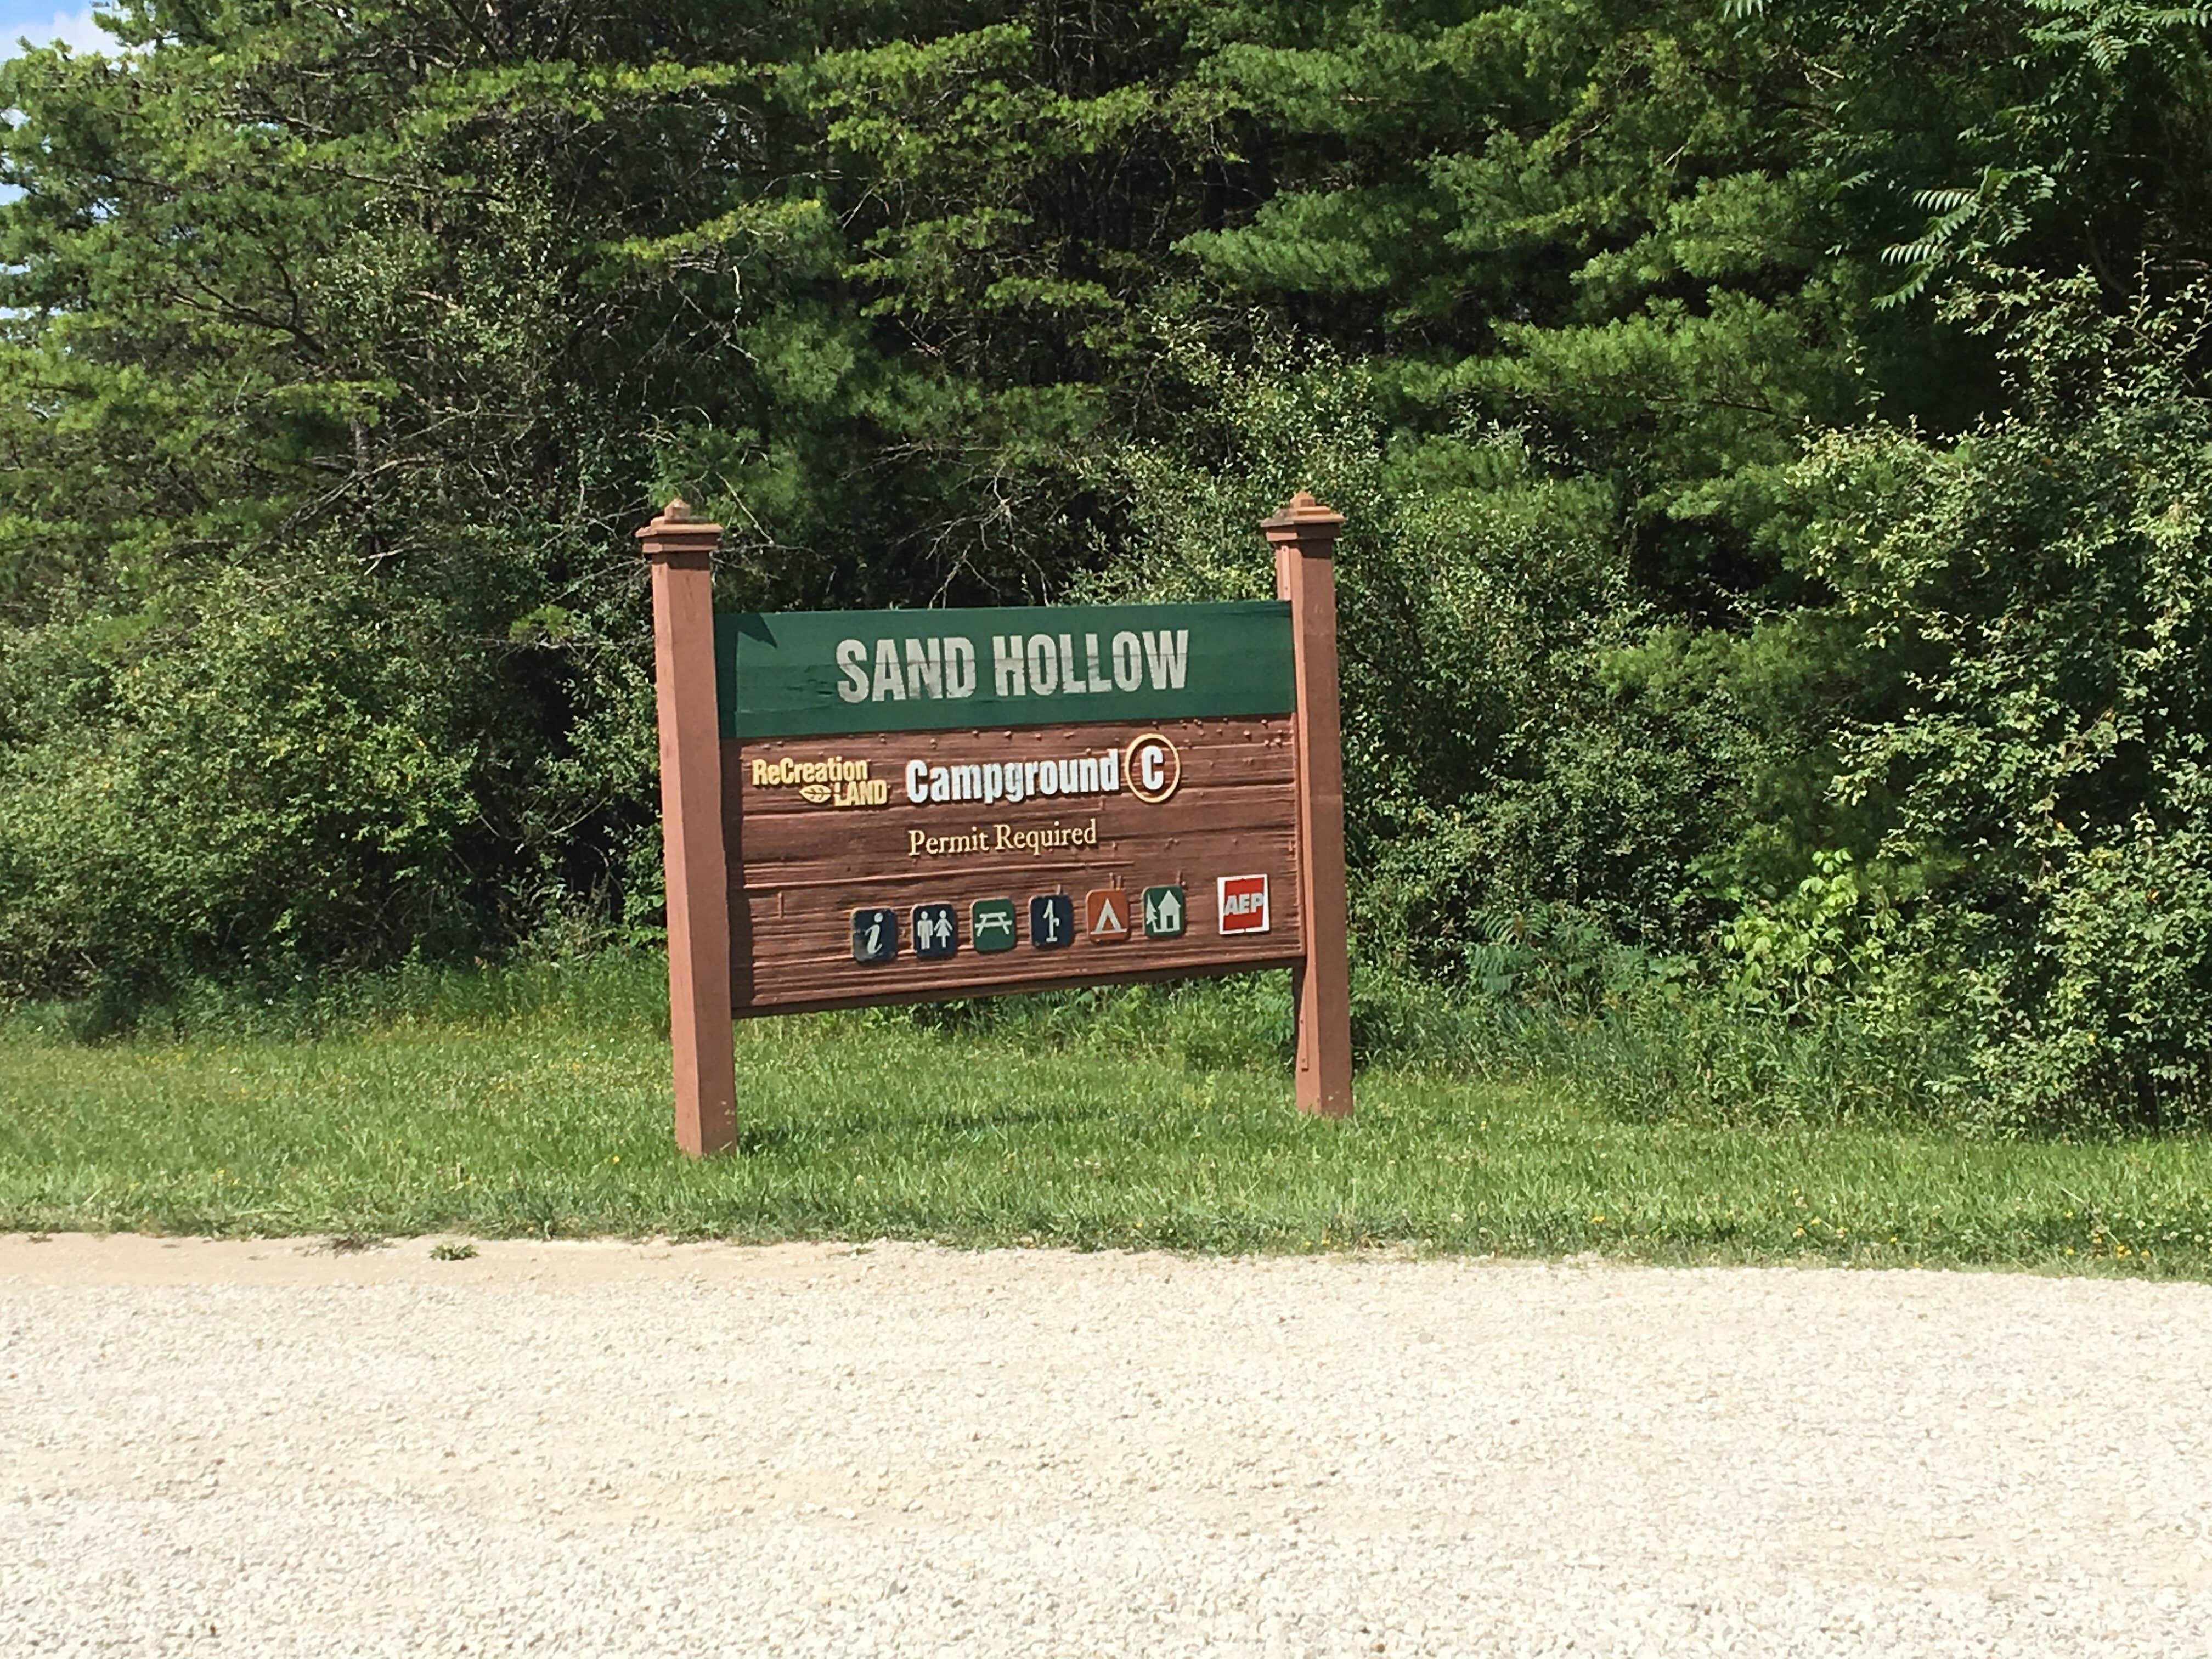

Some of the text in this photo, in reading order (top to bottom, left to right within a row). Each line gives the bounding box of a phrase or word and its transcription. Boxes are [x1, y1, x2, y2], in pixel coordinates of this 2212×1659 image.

[836, 629, 1189, 703] SAND HOLLOW
[752, 756, 868, 785] ReCreation
[905, 745, 1164, 804] Campground C
[833, 780, 888, 806] LAND
[908, 818, 1097, 856] Permit Required
[1224, 892, 1264, 916] AEP
